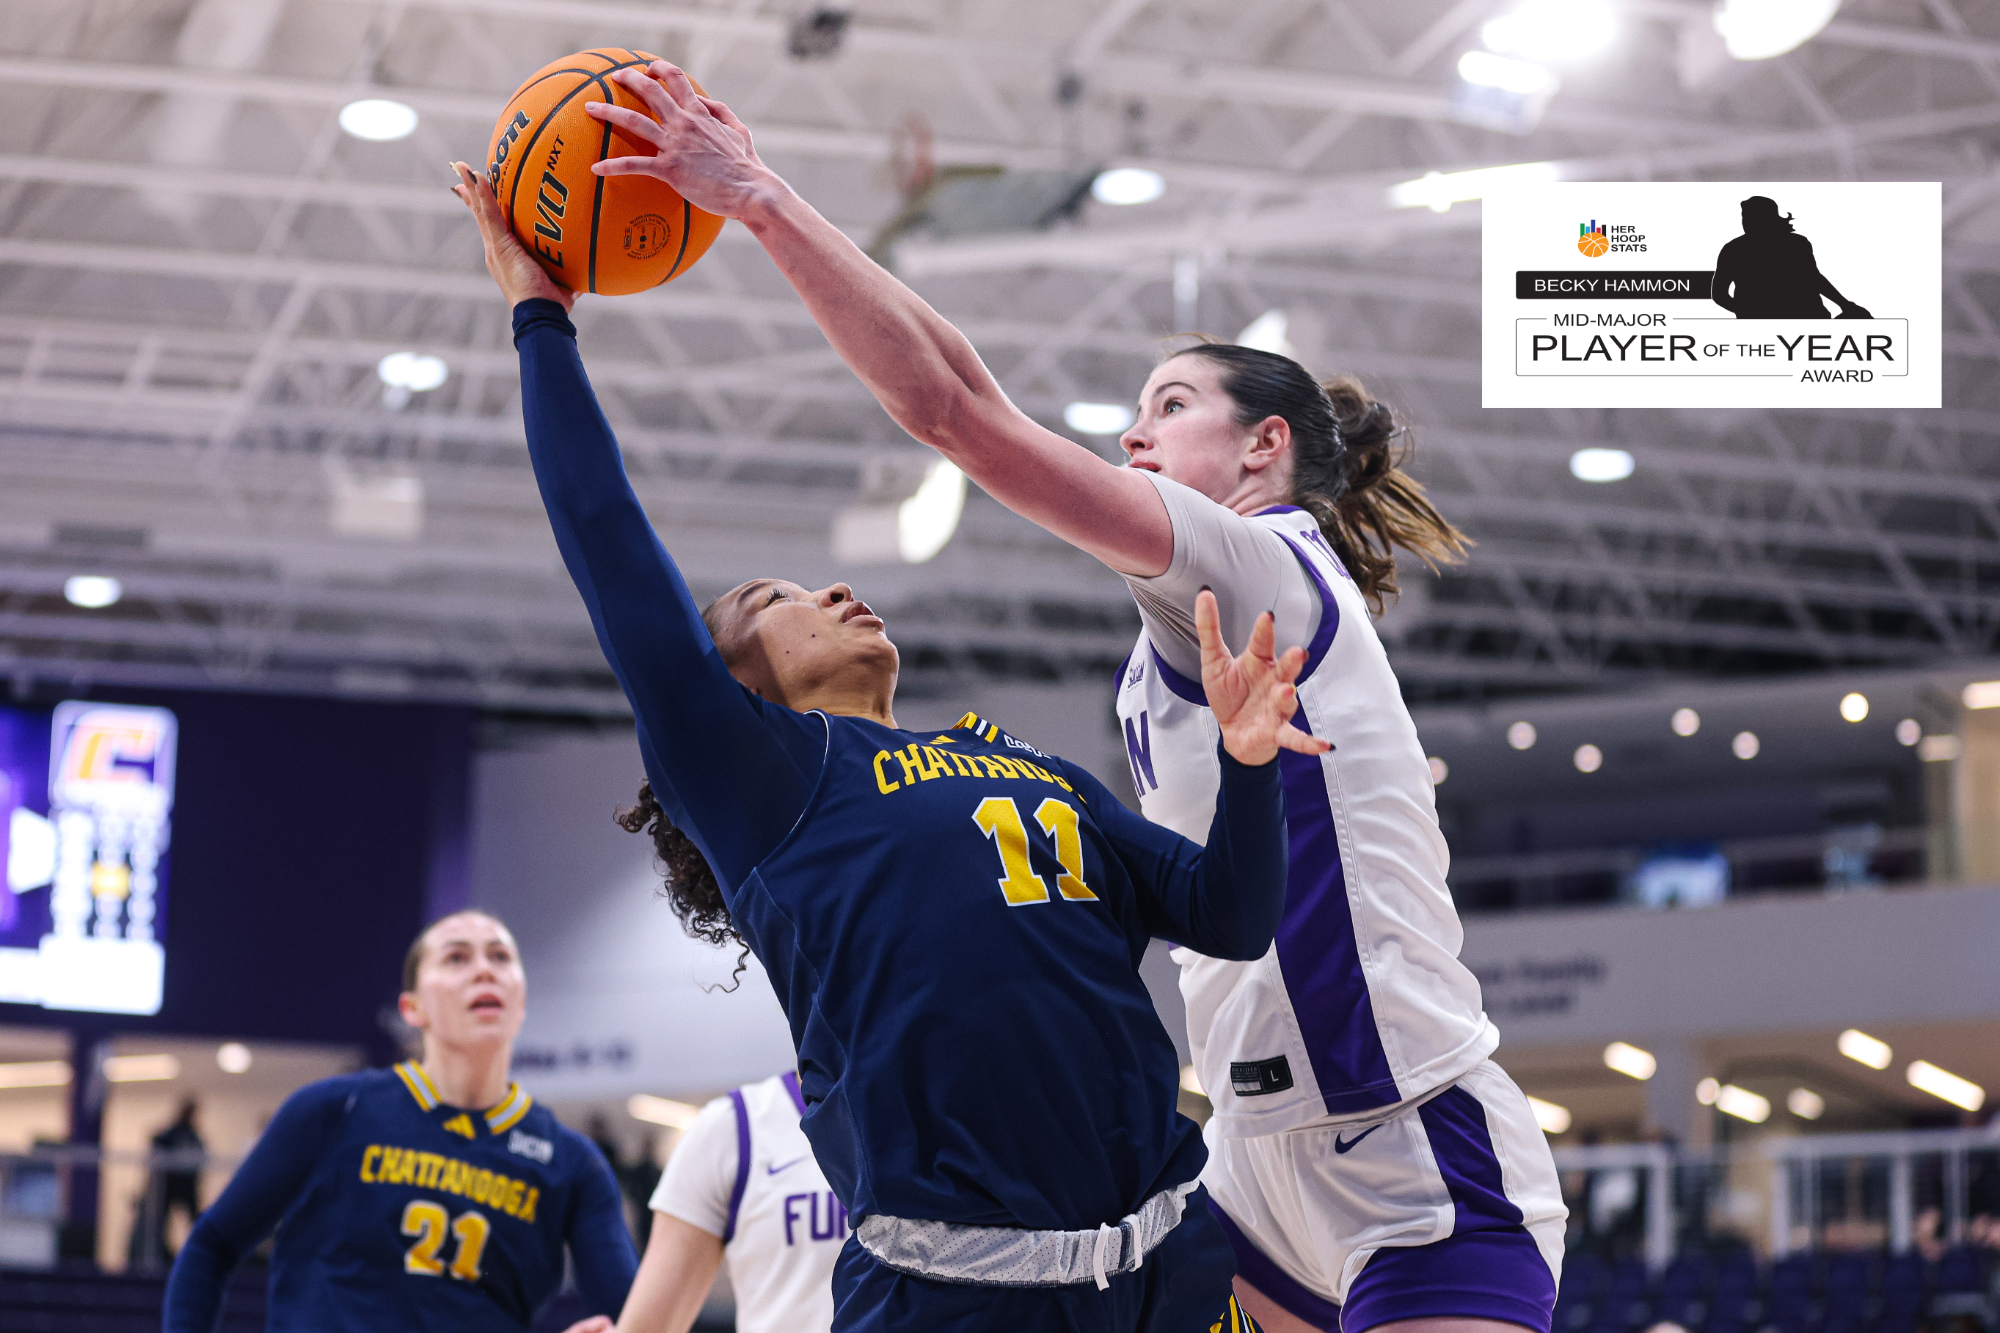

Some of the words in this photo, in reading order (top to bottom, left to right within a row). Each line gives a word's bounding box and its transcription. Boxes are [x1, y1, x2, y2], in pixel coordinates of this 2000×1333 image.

[547, 134, 564, 172] NXT
[534, 169, 569, 269] EVO
[971, 796, 1101, 907] 11
[1270, 1069, 1279, 1082] L
[359, 1144, 541, 1224] CHATTANOOGA
[401, 1199, 491, 1281] 21
